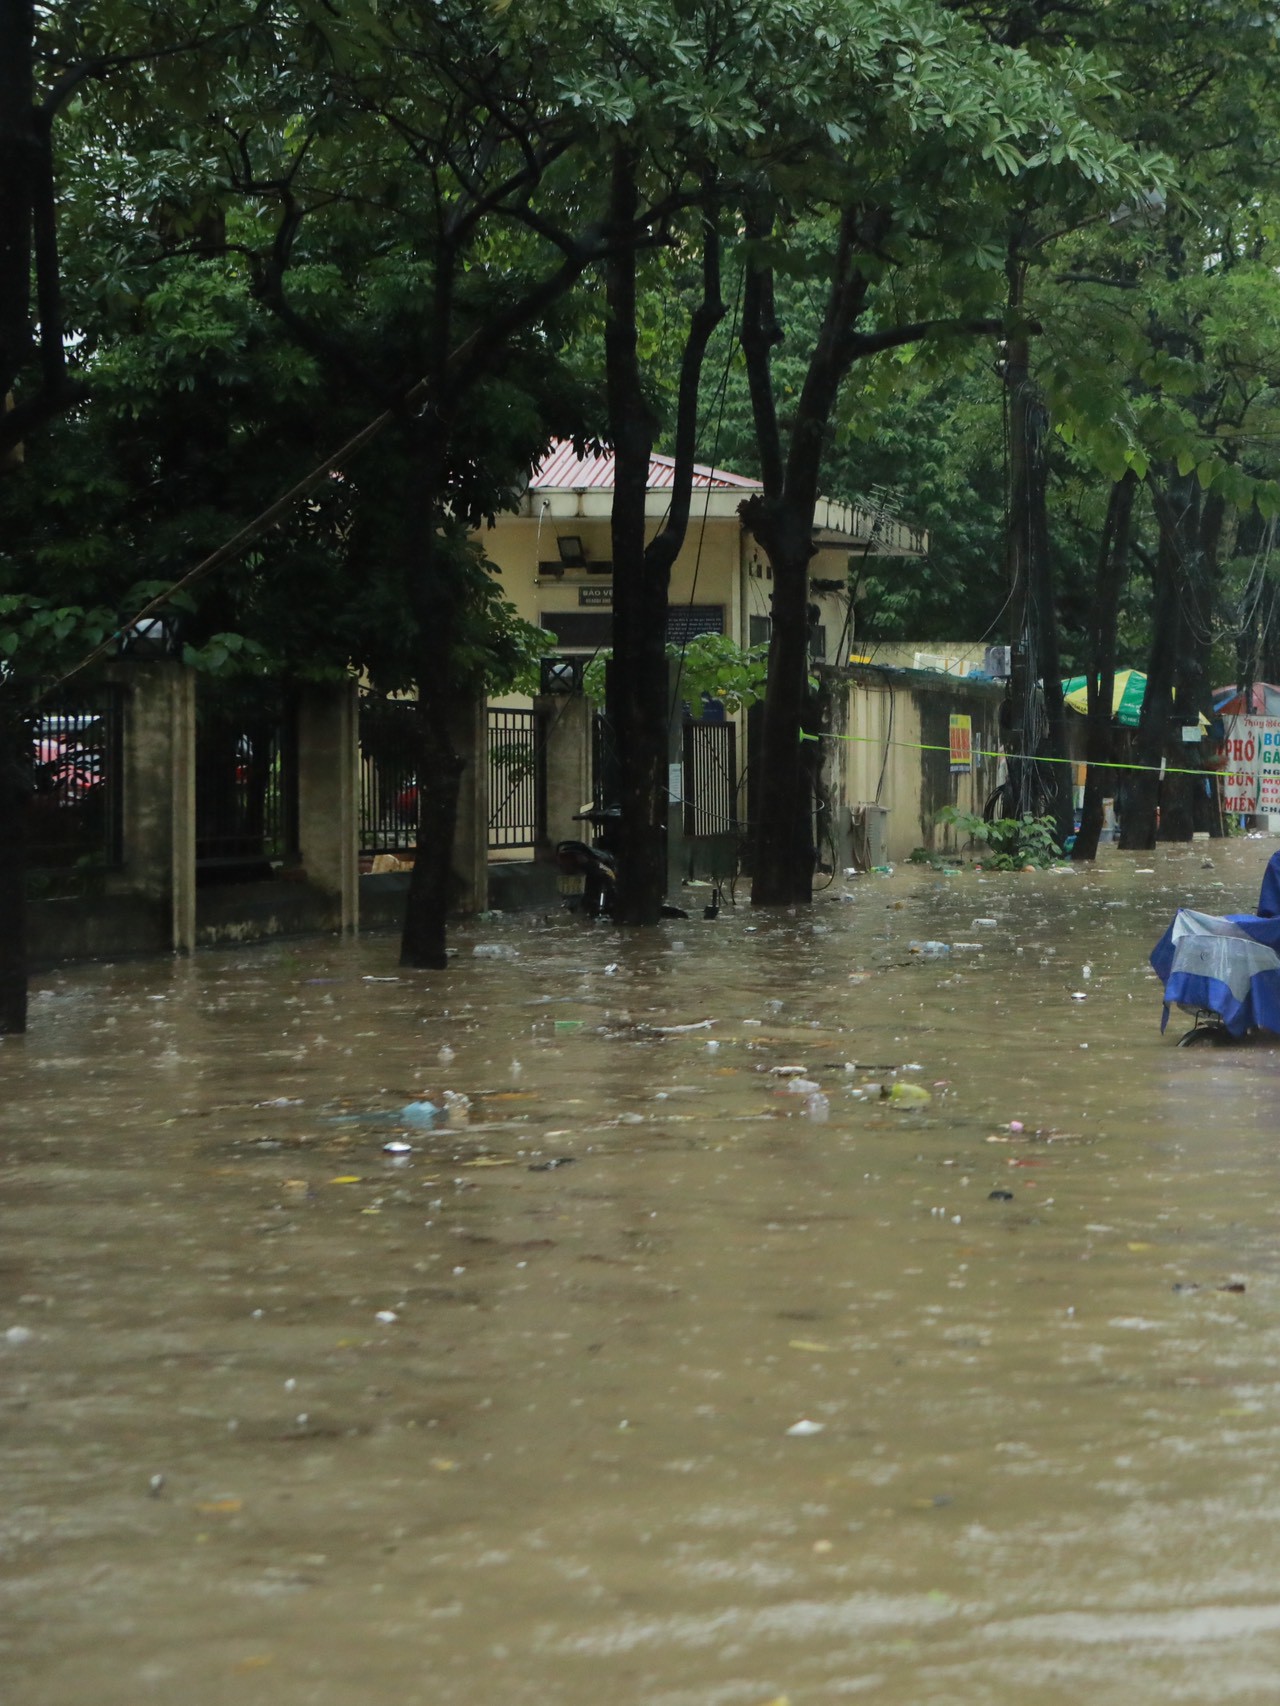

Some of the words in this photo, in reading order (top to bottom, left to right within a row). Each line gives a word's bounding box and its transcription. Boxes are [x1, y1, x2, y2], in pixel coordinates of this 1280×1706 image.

[1226, 731, 1255, 762] PHỞ
[1263, 748, 1280, 764] GÀ
[1228, 768, 1254, 786] BÚN
[1225, 791, 1256, 812] MIẾN
